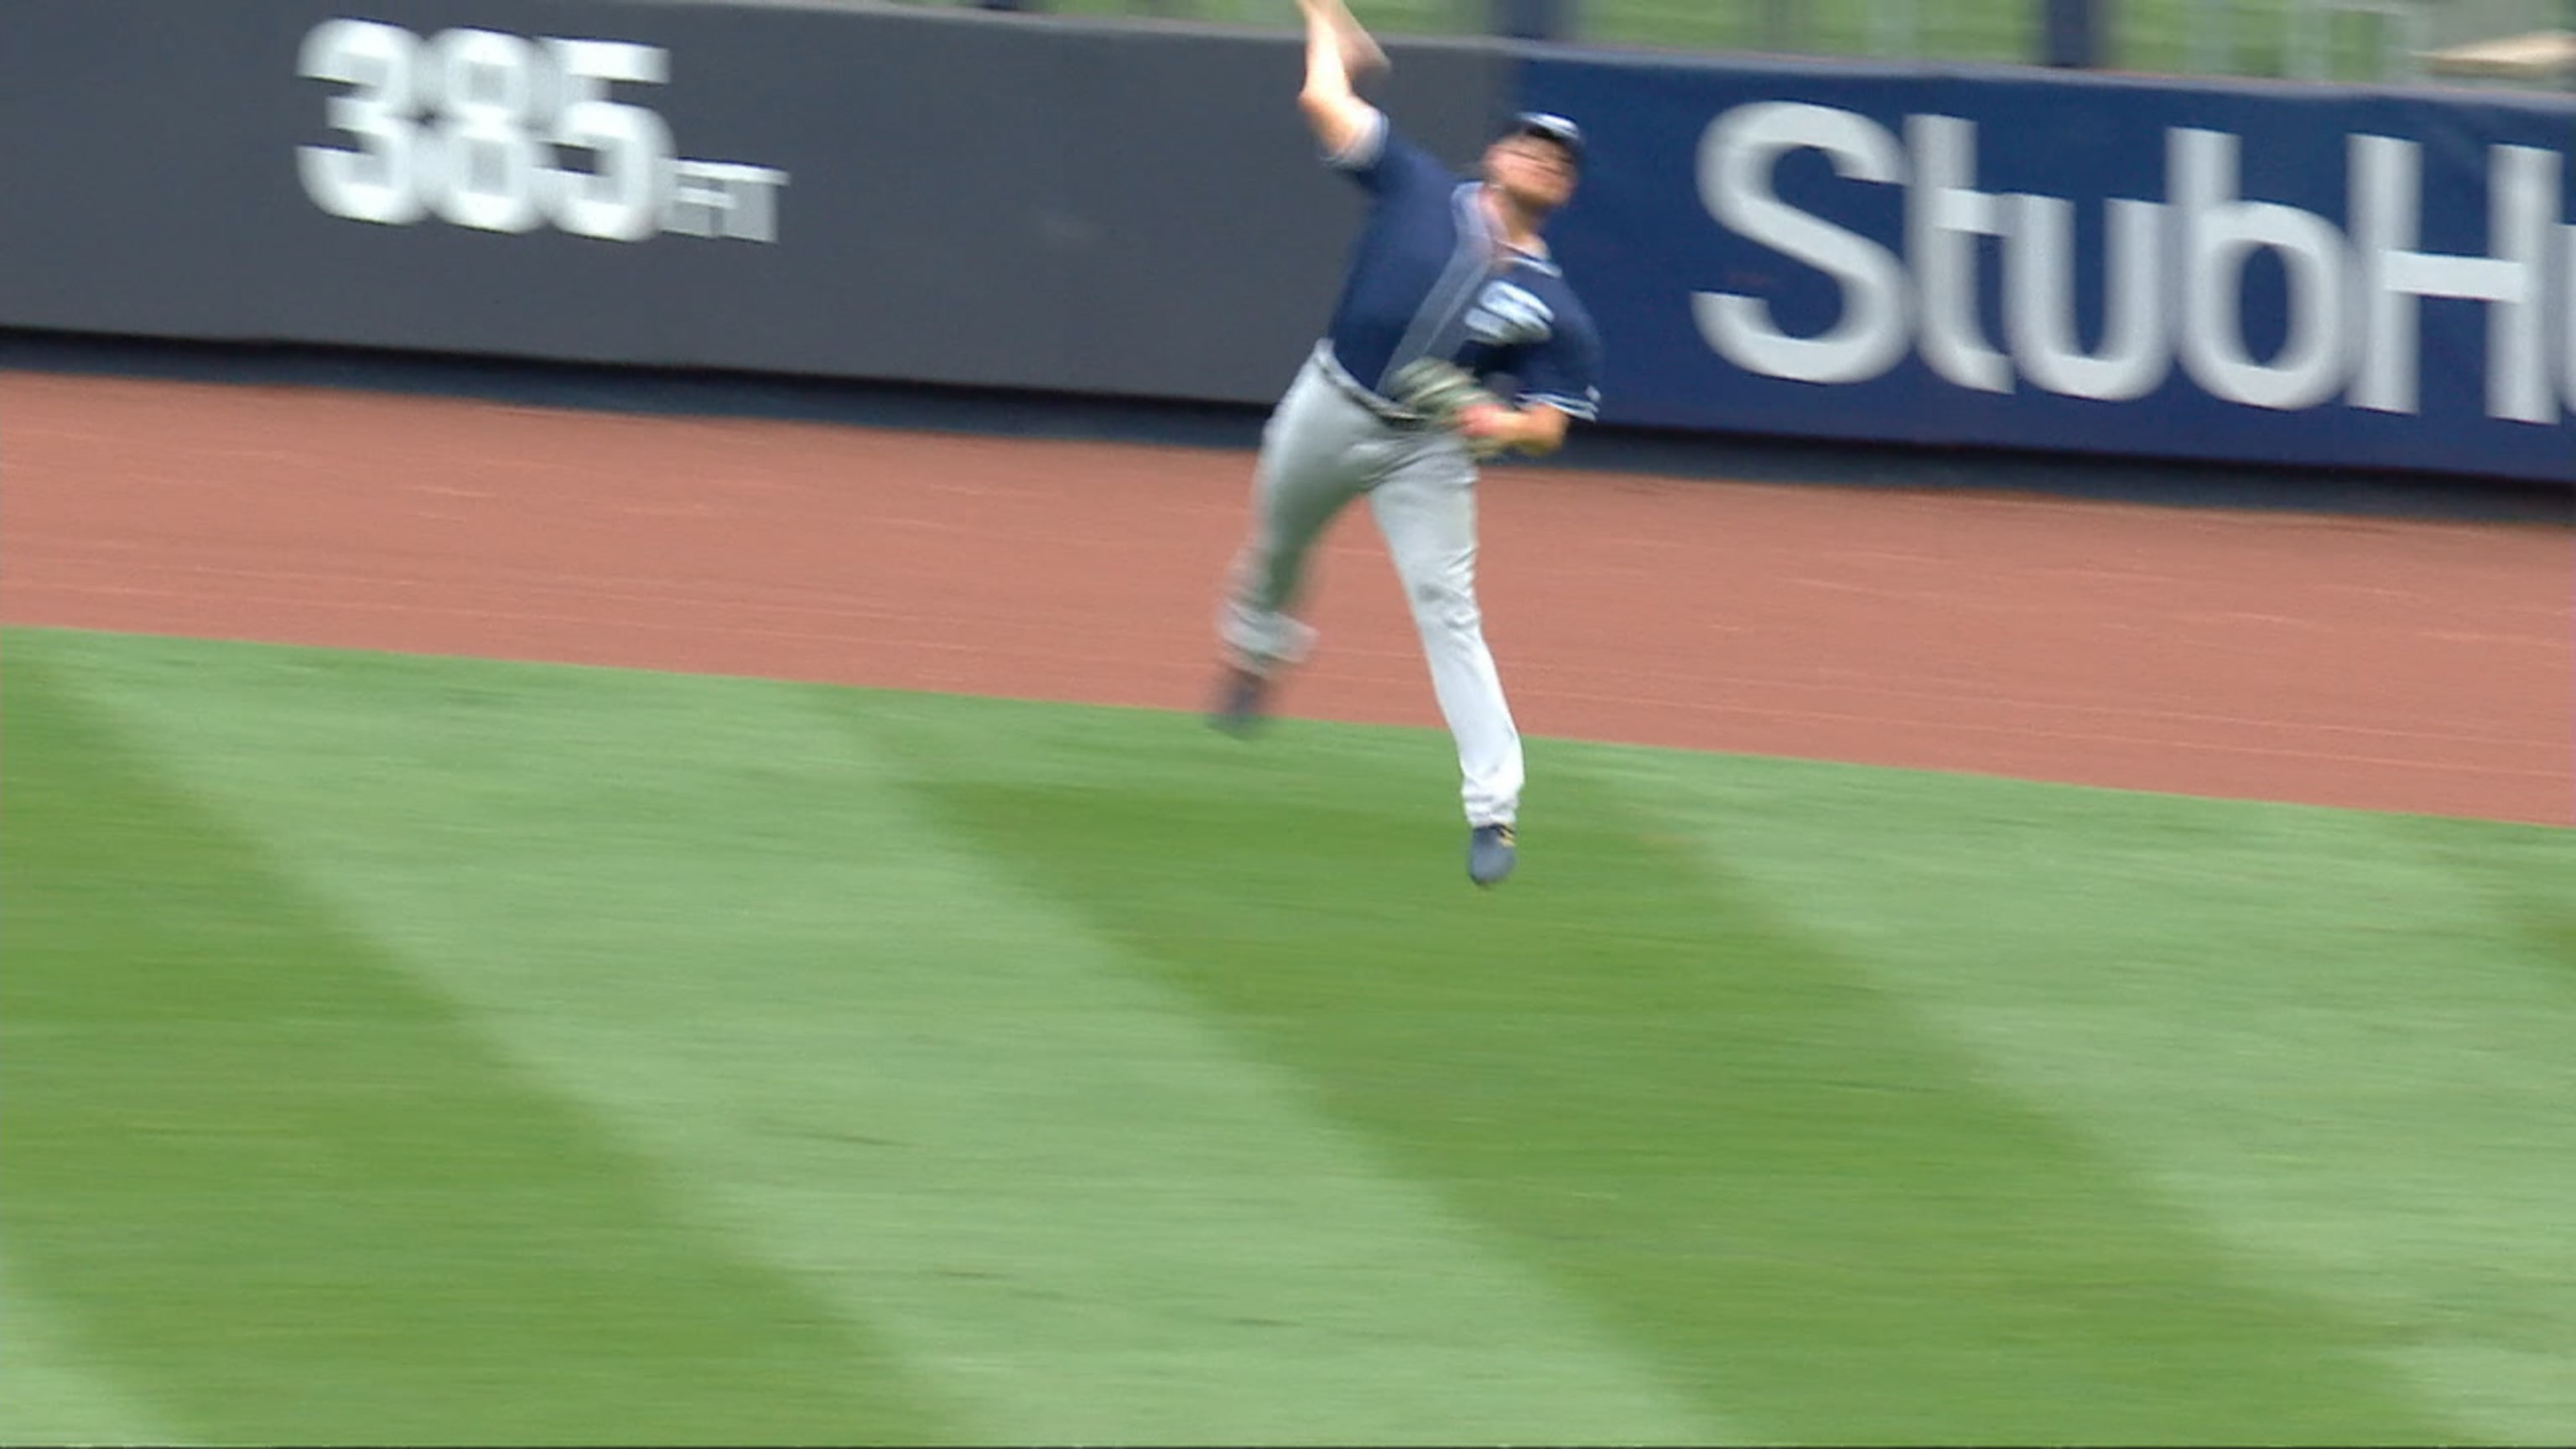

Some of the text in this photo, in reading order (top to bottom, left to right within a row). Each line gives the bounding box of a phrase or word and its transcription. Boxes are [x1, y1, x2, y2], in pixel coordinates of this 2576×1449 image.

[295, 17, 790, 243] 385 FT
[1691, 100, 2576, 426] StubH
